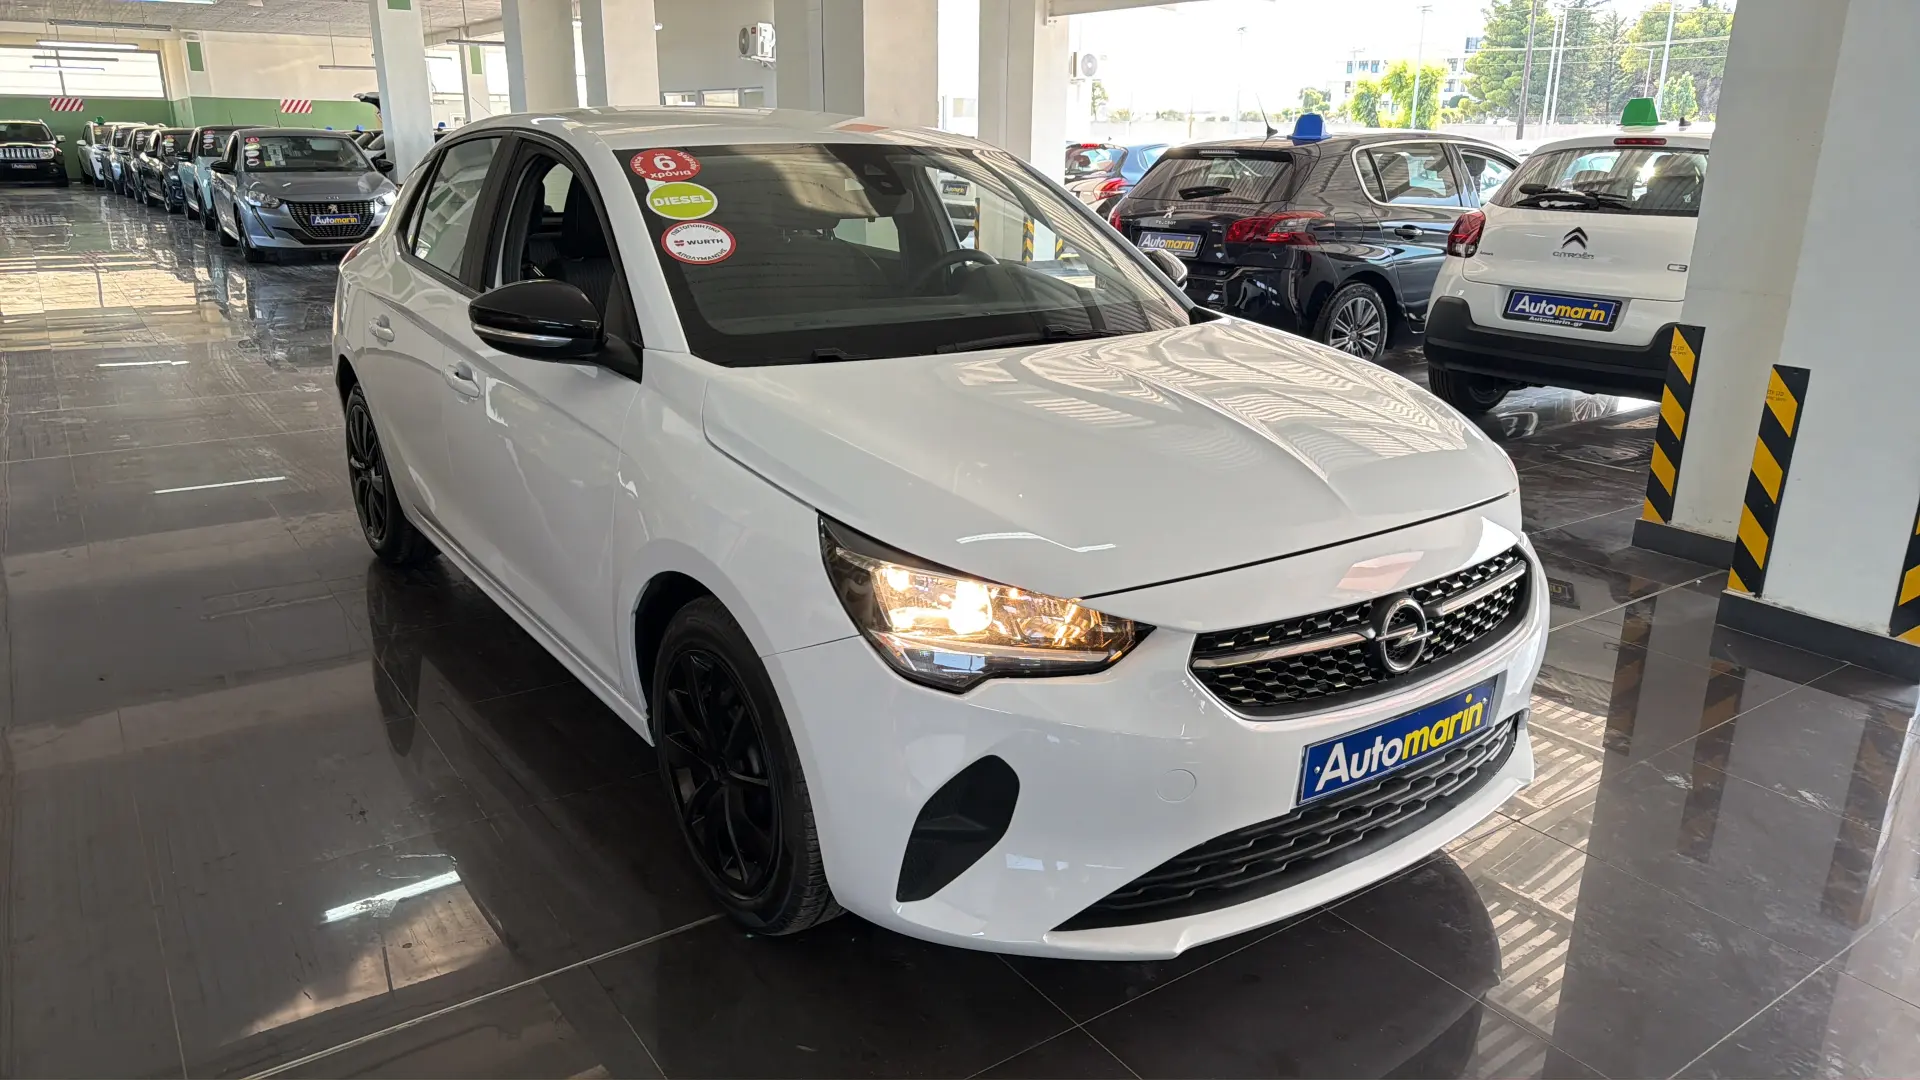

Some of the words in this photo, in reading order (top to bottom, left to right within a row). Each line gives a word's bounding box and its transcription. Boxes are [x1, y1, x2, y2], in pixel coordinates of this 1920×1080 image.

[653, 155, 677, 171] 6
[650, 170, 692, 178] χρόνια
[652, 194, 712, 206] DIESEL
[314, 215, 358, 225] Automarin
[1141, 234, 1195, 250] Automarin
[1666, 263, 1688, 272] C3
[1514, 295, 1606, 322] Automarin
[1314, 692, 1483, 792] Automarin
